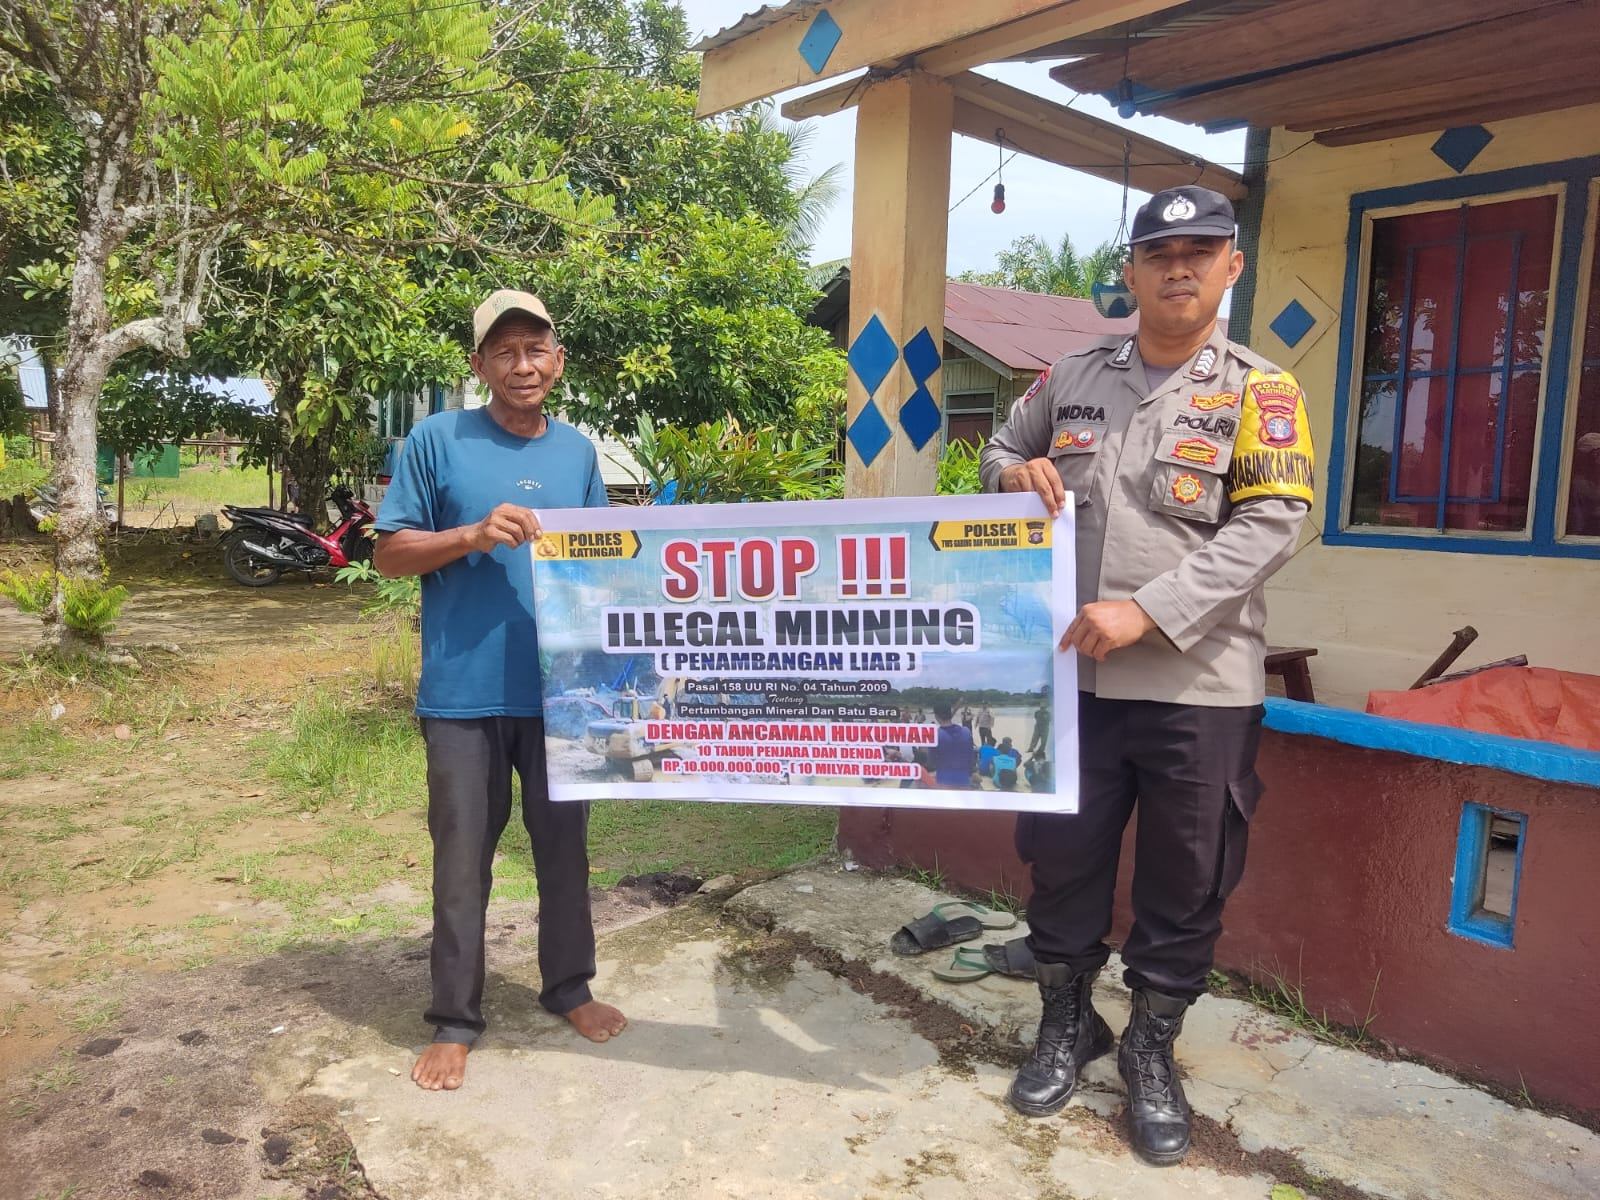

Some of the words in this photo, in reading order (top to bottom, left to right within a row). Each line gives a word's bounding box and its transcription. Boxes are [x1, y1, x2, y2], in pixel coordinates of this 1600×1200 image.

[1056, 404, 1105, 421] INDRA
[1173, 414, 1236, 437] POLRI
[964, 522, 1016, 537] POLSEK
[568, 532, 622, 546] POLRES
[569, 547, 623, 559] KATINGAN
[664, 538, 816, 600] STOP
[840, 536, 906, 596] !!!
[607, 611, 764, 647] ILLEGAL
[775, 608, 974, 646] MINNING
[675, 652, 843, 671] PENAMBANGAN
[850, 652, 901, 671] LIAR
[687, 682, 719, 692] Pasal
[722, 682, 742, 692] 158
[745, 682, 762, 692] UU
[766, 682, 777, 692] RI
[781, 682, 800, 692] No.
[803, 682, 817, 692] 04
[820, 682, 857, 692] Tahun
[859, 683, 888, 693] 2009
[768, 693, 804, 705] Tentang
[680, 706, 762, 717] Pertambangan
[765, 706, 808, 716] Mineral
[811, 706, 835, 716] Dan
[838, 707, 866, 717] Batu
[869, 707, 898, 717] Bara
[646, 723, 724, 741] DENGAN
[727, 723, 826, 742] ANCAMAN
[831, 725, 936, 743] HUKUMAN
[697, 745, 711, 757] 10
[714, 745, 754, 758] TAHUN
[757, 745, 809, 759] PENJARA
[812, 746, 838, 759] DAN
[840, 747, 882, 760] DENDA
[663, 760, 681, 772] RP.
[798, 762, 812, 775] 10
[815, 763, 860, 776] MILYAR
[863, 764, 911, 777] RUPIAH
